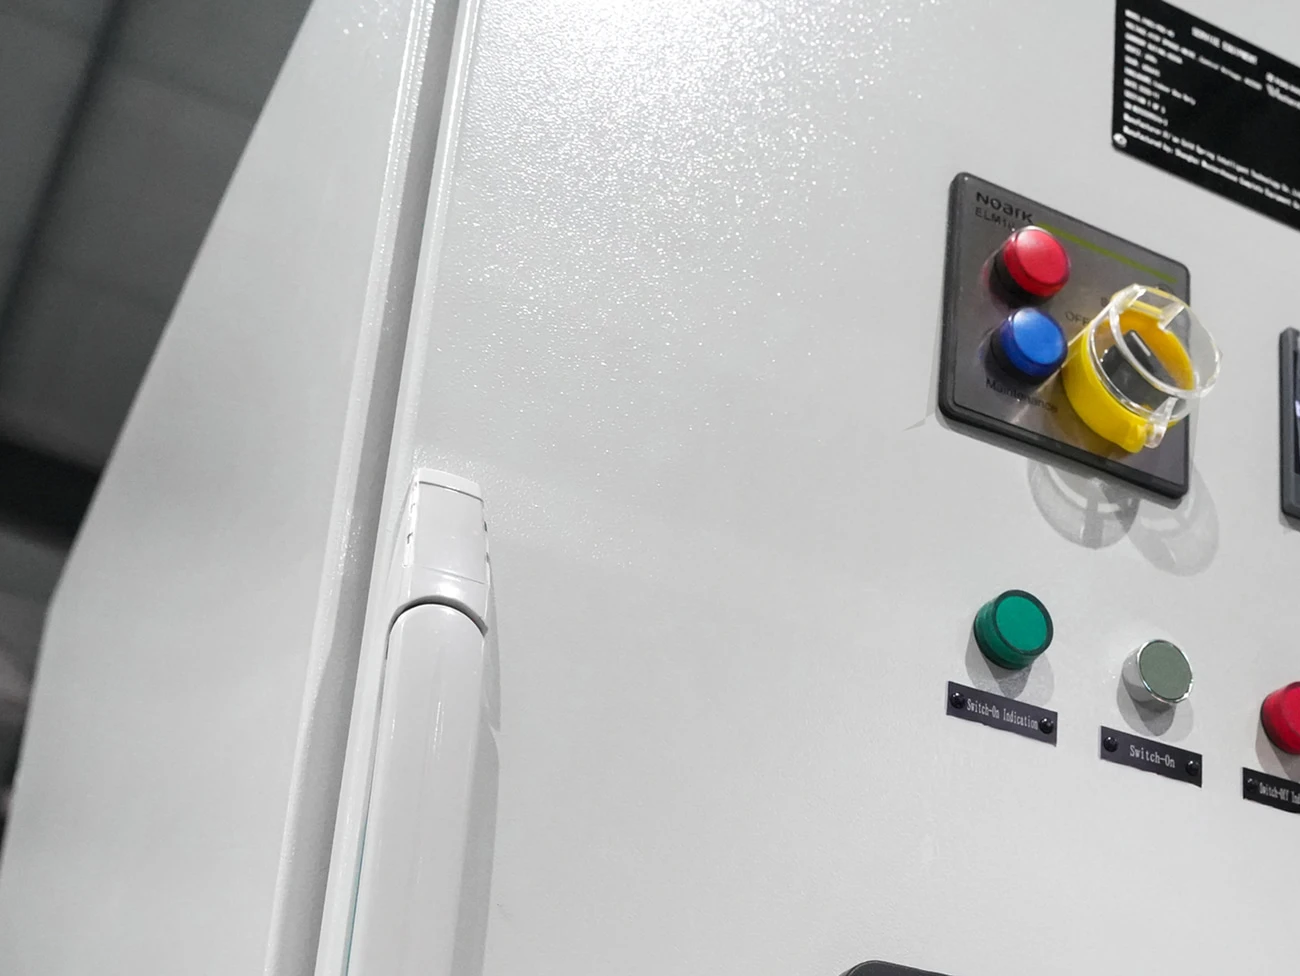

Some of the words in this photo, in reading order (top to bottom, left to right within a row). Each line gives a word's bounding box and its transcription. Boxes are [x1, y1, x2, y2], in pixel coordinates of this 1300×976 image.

[966, 698, 1000, 719] Switch-On
[1003, 708, 1039, 731] Indication
[1130, 744, 1176, 768] Switch-On
